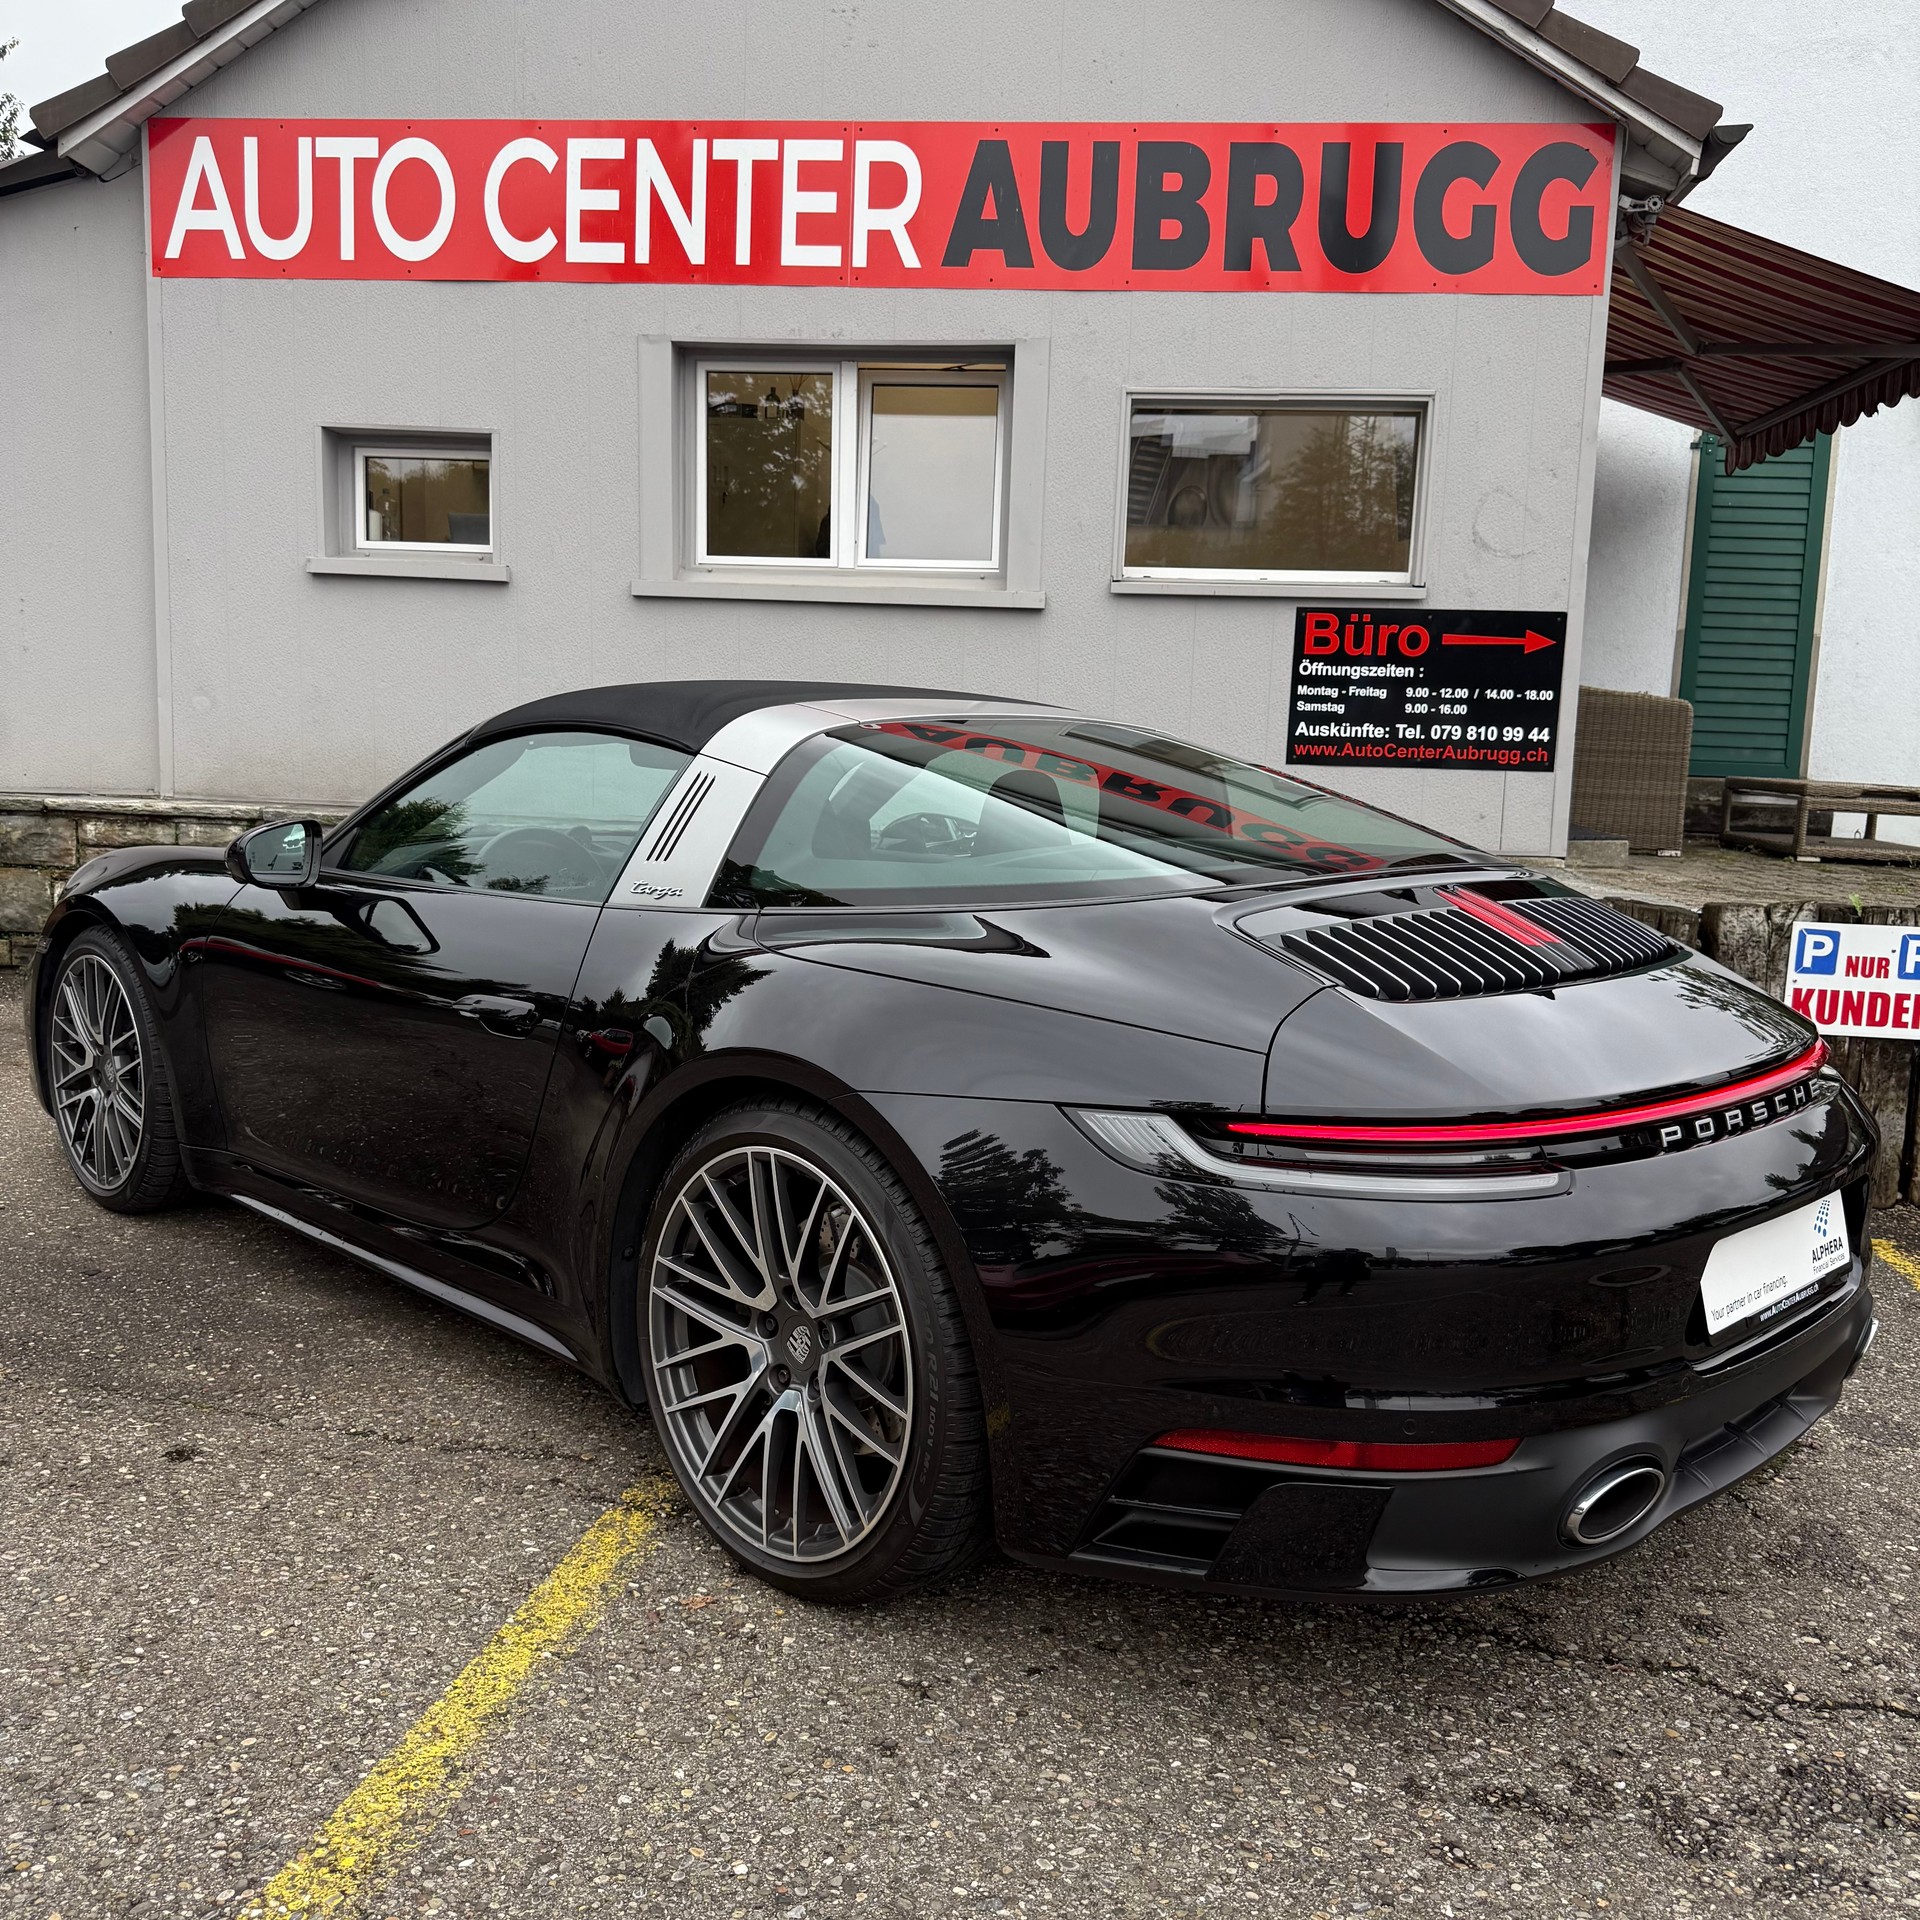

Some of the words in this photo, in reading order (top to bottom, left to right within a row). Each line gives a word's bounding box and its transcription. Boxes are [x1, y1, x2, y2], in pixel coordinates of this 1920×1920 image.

[164, 136, 456, 262] AUTO
[484, 137, 922, 268] CENTER
[941, 140, 1600, 277] AUBRUGG
[1303, 612, 1430, 657] Büro
[1299, 659, 1414, 679] Öffnungszeiten
[1297, 685, 1339, 699] Montag
[1348, 686, 1387, 699] Freitag
[1405, 687, 1429, 699] 9.00
[1439, 688, 1469, 699] 12.00
[1485, 689, 1514, 700] 14.00
[1525, 690, 1553, 701] 18.00
[1296, 701, 1345, 715] Samstag
[1404, 703, 1428, 714] 9.00
[1438, 704, 1467, 715] 16.00
[1295, 722, 1390, 739] Auskünfte:
[1396, 724, 1425, 739] Tel.
[1430, 725, 1462, 740] 079
[1466, 726, 1498, 741] 810
[1502, 727, 1524, 742] 99
[1528, 727, 1550, 742] 44
[1294, 743, 1548, 765] www.AutoCenterAubrugg.ch
[1802, 934, 1834, 968] P
[1845, 955, 1890, 979] NUR
[1791, 988, 1920, 1029] KUNDE
[1660, 1078, 1820, 1147] PORSCHE
[1812, 1236, 1844, 1264] ALPHERA
[1711, 1306, 1725, 1322] Your
[1725, 1295, 1746, 1317] partner
[1753, 1287, 1763, 1300] car
[1762, 1275, 1789, 1296] financing.
[927, 1350, 939, 1402] R21
